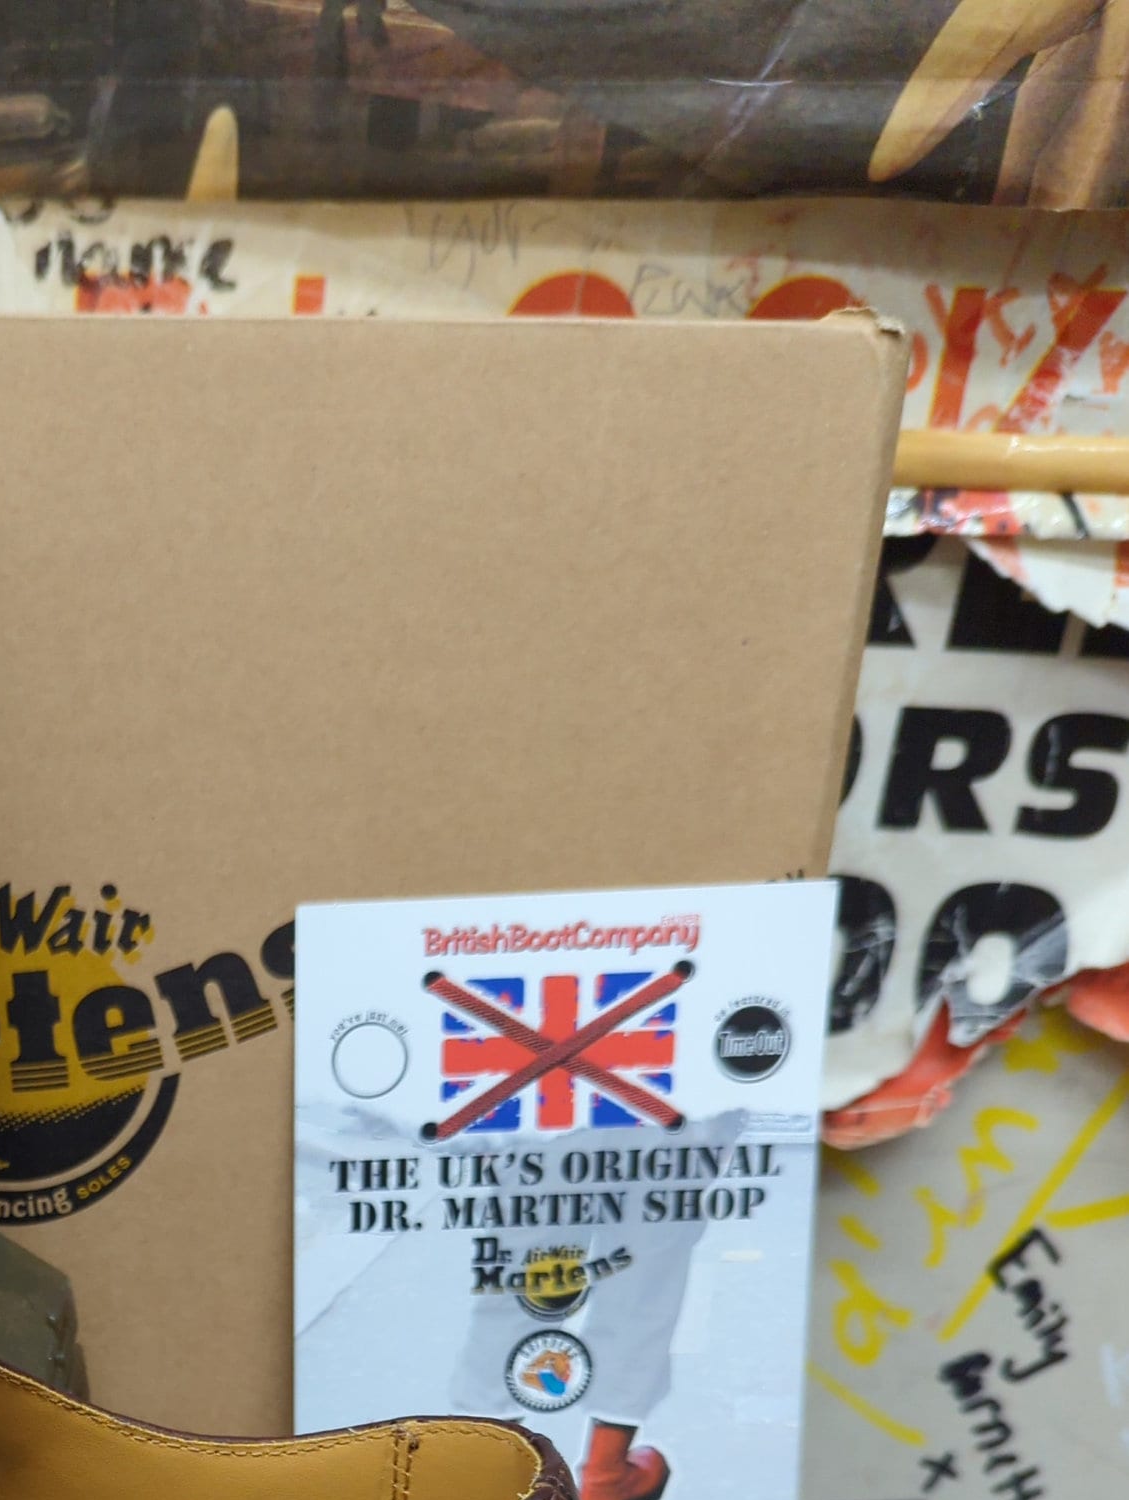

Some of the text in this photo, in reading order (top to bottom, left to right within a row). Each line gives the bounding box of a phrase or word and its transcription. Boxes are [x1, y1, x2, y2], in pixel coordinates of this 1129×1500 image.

[77, 1156, 132, 1201] SOLES
[329, 1143, 781, 1192] THE UK'S ORIGINAL
[349, 1186, 766, 1233] DR. MARTEN SHOP
[471, 1247, 633, 1294] Martens
[988, 1228, 1070, 1383] Emily
